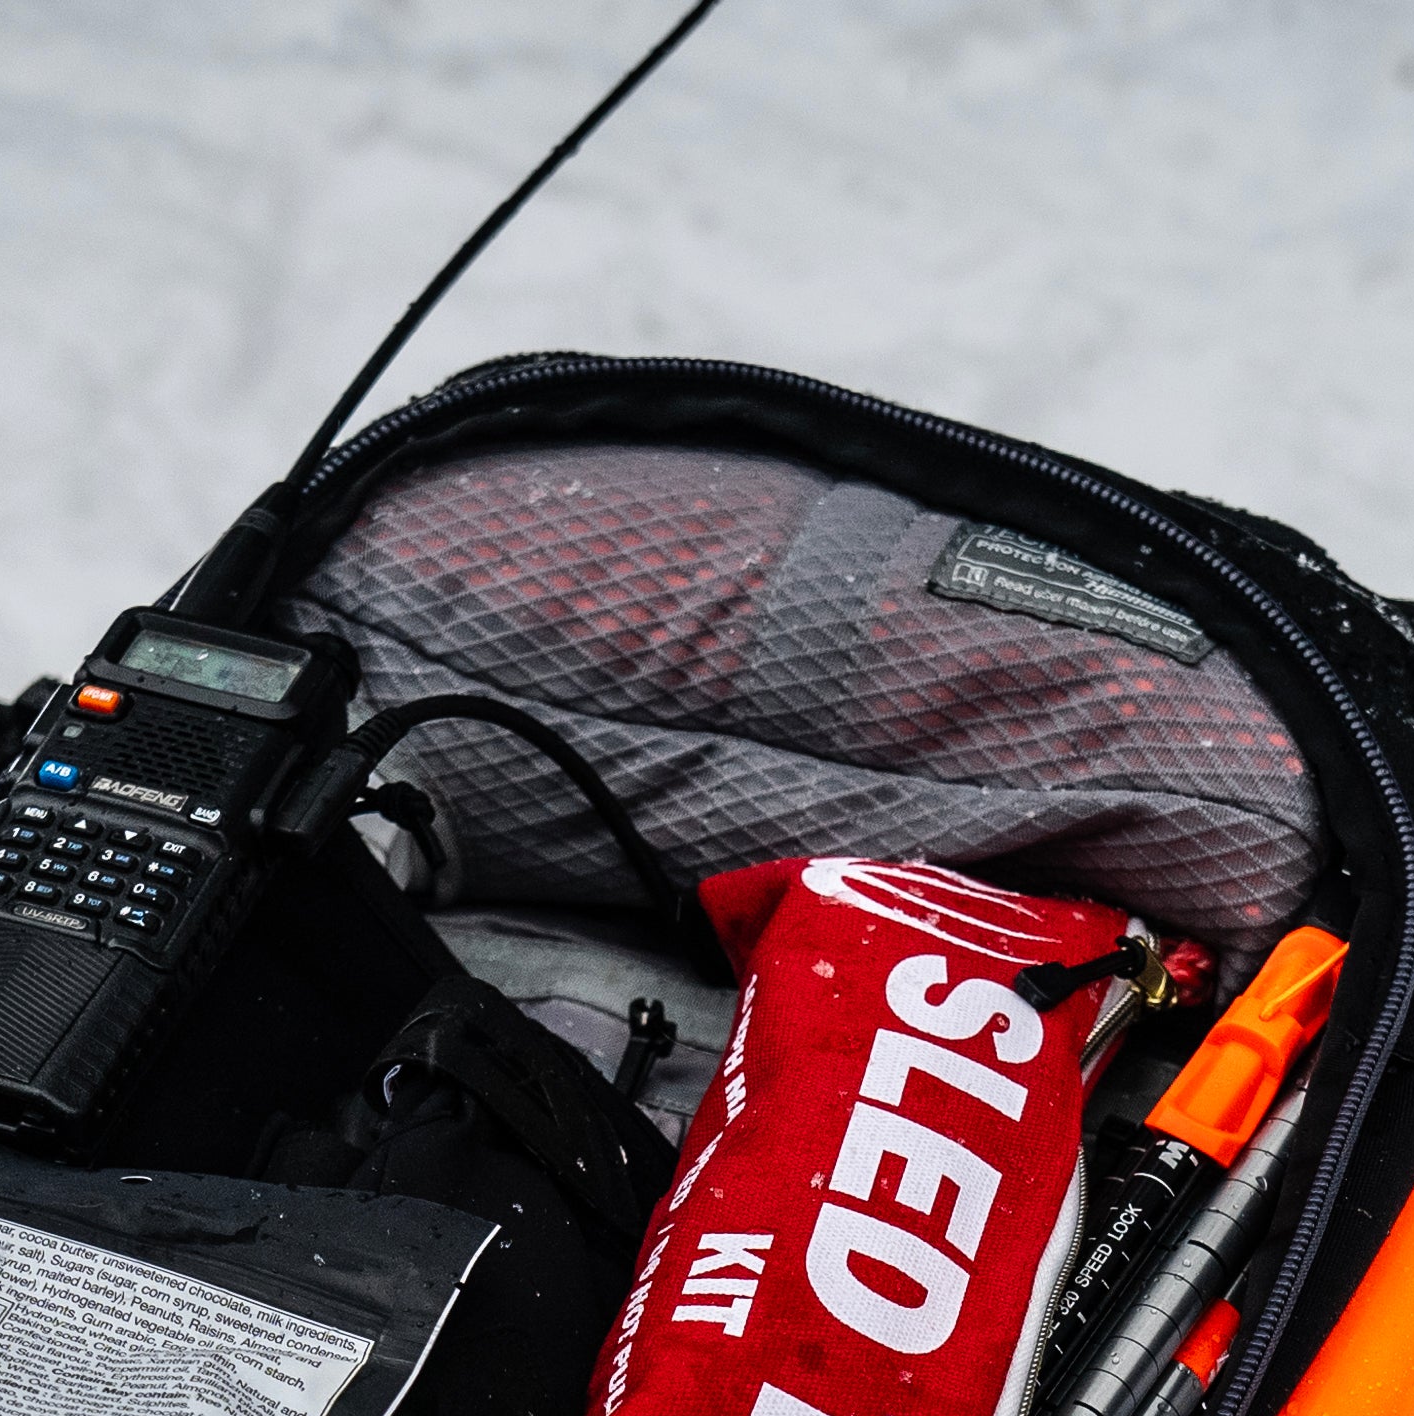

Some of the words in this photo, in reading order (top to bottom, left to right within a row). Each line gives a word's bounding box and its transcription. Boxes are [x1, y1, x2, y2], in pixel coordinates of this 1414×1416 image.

[976, 539, 1082, 575] PROTECON
[993, 576, 1034, 595] Read
[1115, 607, 1161, 632] before
[45, 763, 72, 777] A/B
[92, 777, 184, 807] BAOFENG
[24, 807, 48, 819] MENU
[12, 827, 20, 838] 1
[53, 837, 67, 849] 2
[162, 841, 187, 854] EXIT
[39, 858, 52, 870] 5
[101, 849, 114, 861] 3
[24, 881, 37, 892] 8
[87, 870, 100, 881] 6
[132, 883, 145, 894] 0
[73, 893, 86, 904] 9
[805, 953, 1044, 1355] SLED
[1059, 1289, 1081, 1317] 320
[1074, 1242, 1114, 1289] SPEED
[1106, 1202, 1144, 1242] LOCK
[18, 1229, 58, 1250] cocoa
[59, 1241, 100, 1264] butter,
[102, 1256, 189, 1292] unsweetened
[188, 1281, 253, 1318] chocolate,
[256, 1308, 284, 1328] milk
[286, 1317, 358, 1354] ingredients,
[672, 1233, 774, 1338] KIT
[5, 1284, 78, 1321] ingredients,
[81, 1311, 115, 1332] Gum
[114, 1325, 159, 1347] arabic,
[17, 1245, 47, 1266] salt),
[50, 1253, 96, 1278] Sugars
[96, 1267, 138, 1293] (sugar,
[141, 1284, 172, 1304] corn
[172, 1296, 212, 1321] syrup,
[214, 1311, 285, 1346] sweetened
[287, 1337, 359, 1365] condensed
[37, 1266, 79, 1289] malted
[82, 1279, 127, 1306] barley),
[130, 1296, 186, 1328] Peanuts,
[188, 1316, 238, 1346] Raisins,
[41, 1281, 133, 1323] Hydrogenated
[134, 1314, 196, 1345] vegetable
[197, 1337, 214, 1350] oil
[618, 1281, 654, 1344] NOT
[7, 1312, 53, 1334] Baking
[14, 1302, 87, 1335] Hydrolyzed
[88, 1329, 129, 1348] wheat
[234, 1352, 265, 1371] corn
[264, 1366, 307, 1392] starch,
[236, 1378, 282, 1410] Natural
